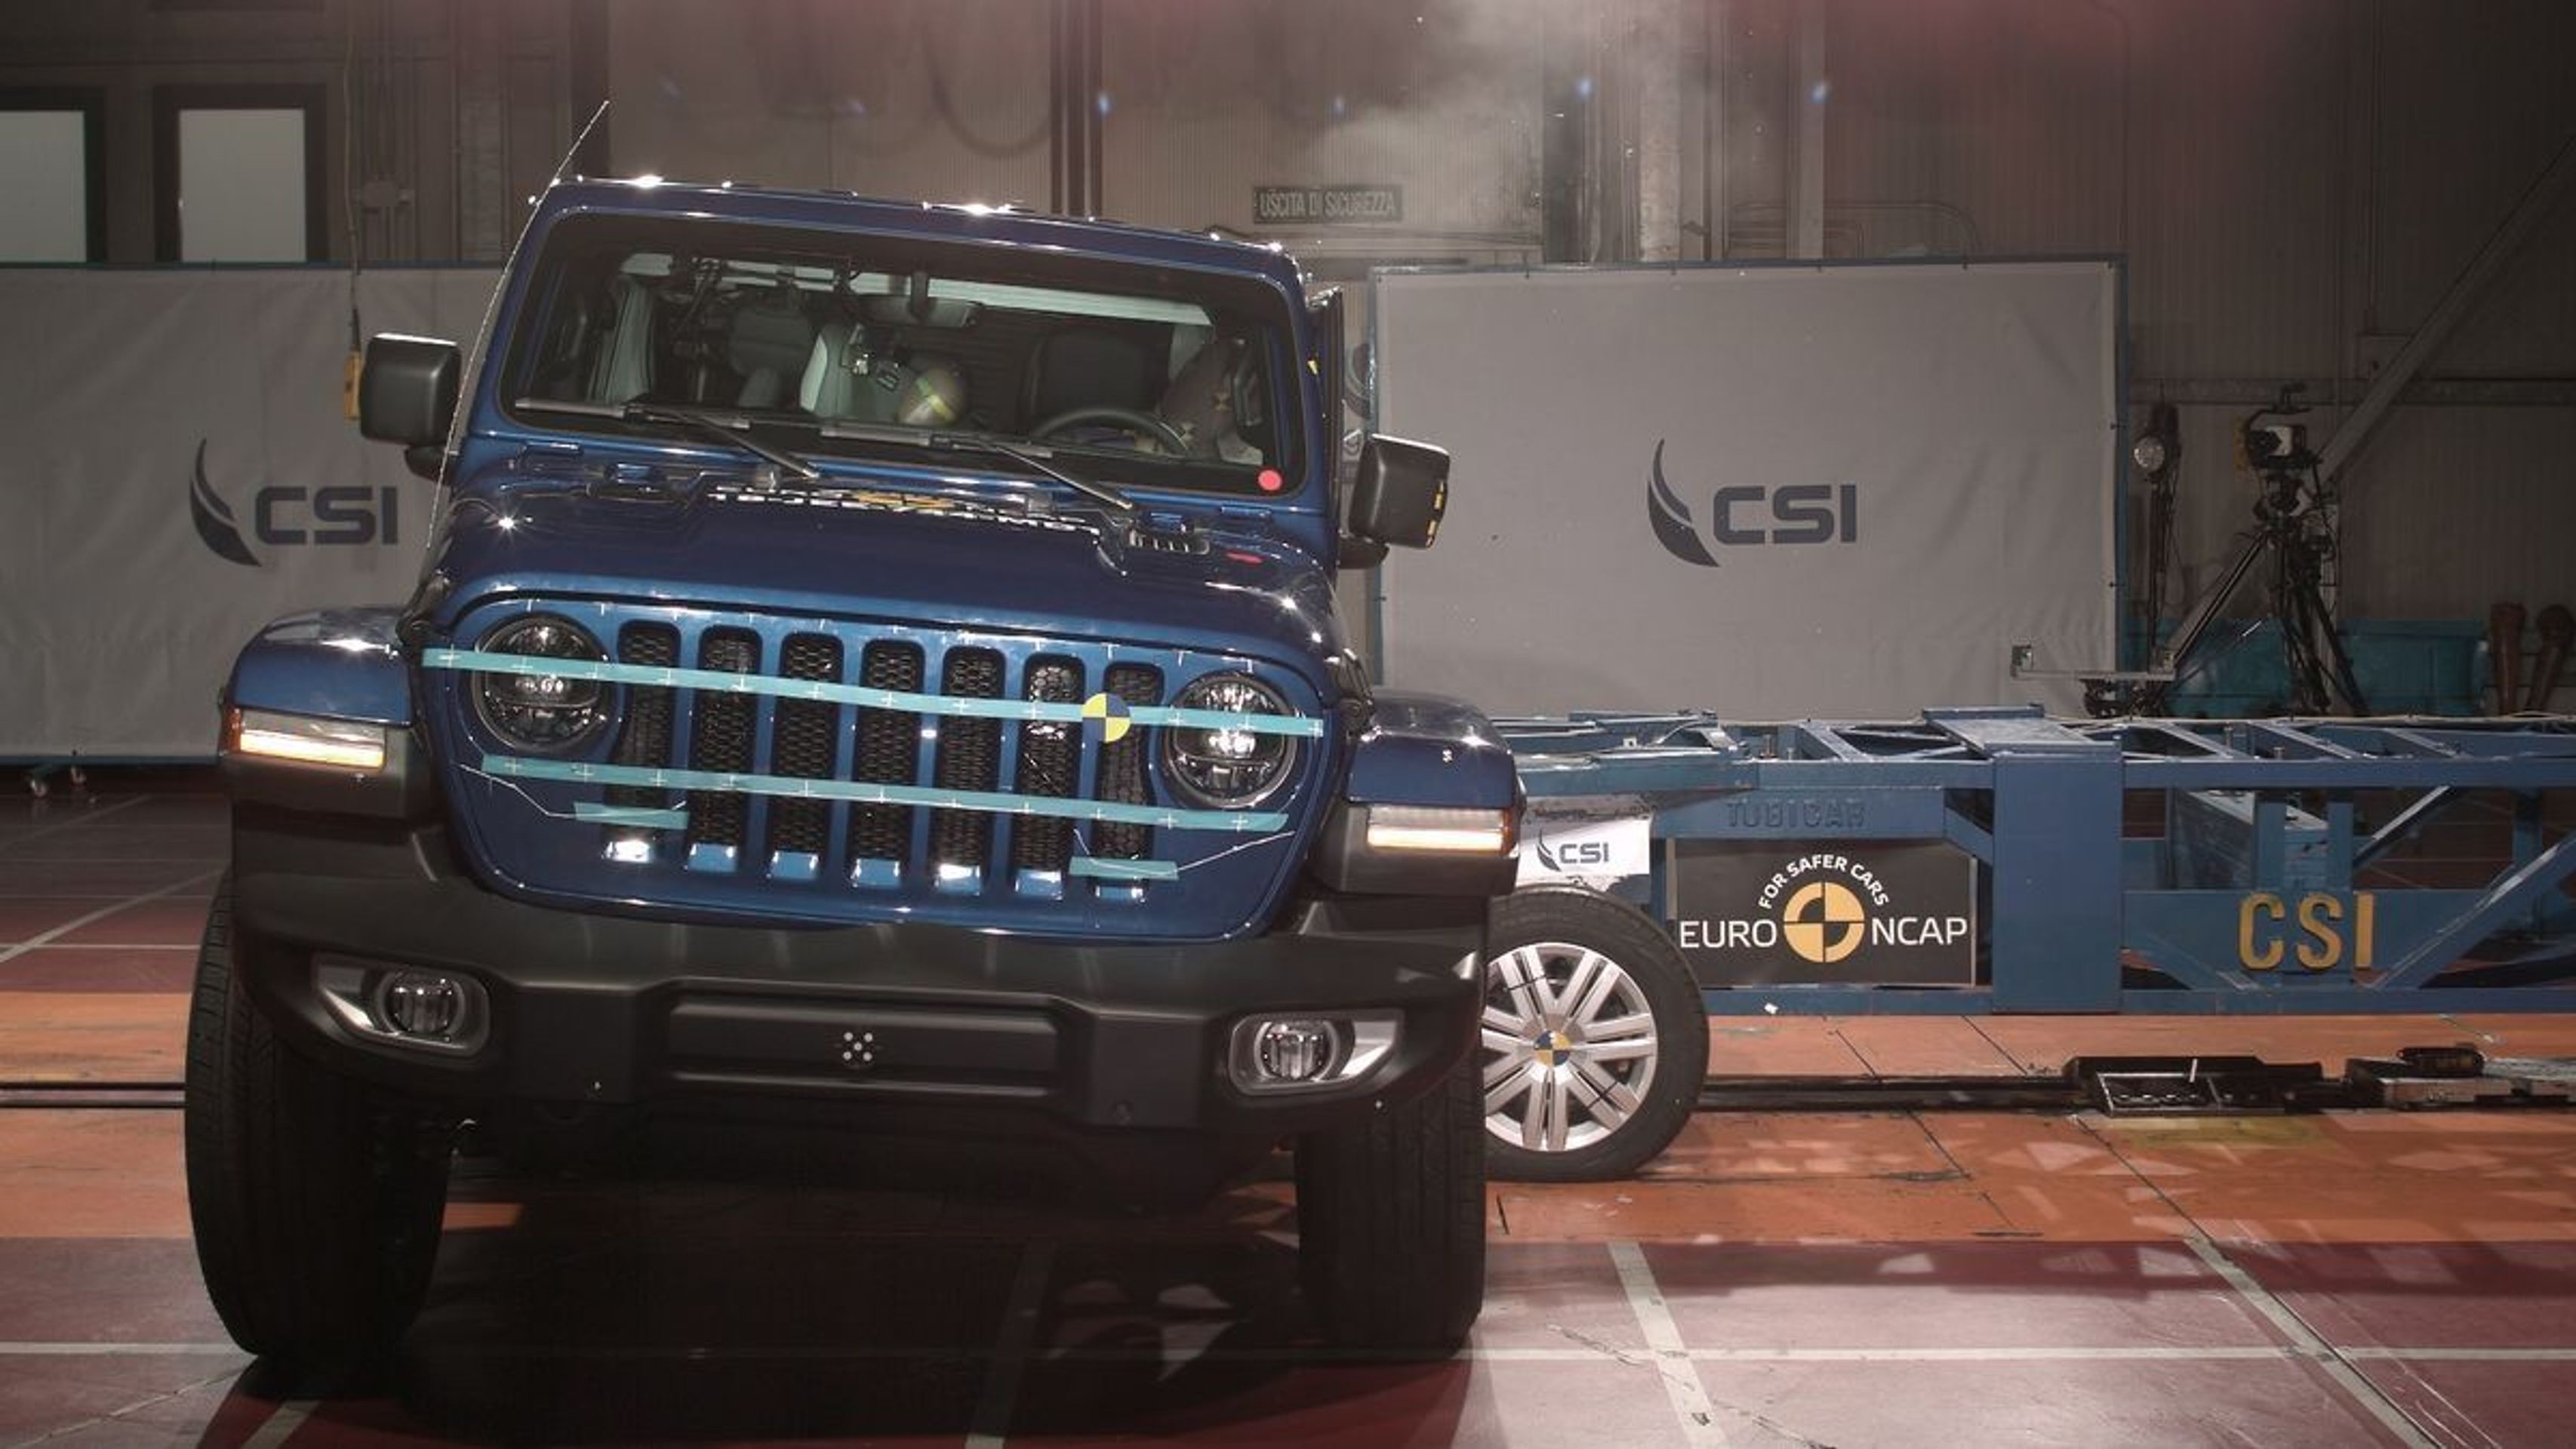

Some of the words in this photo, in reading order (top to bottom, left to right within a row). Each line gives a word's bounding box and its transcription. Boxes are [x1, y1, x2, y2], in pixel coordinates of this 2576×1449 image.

[1260, 192, 1306, 217] USCITA
[1325, 191, 1396, 217] SICUREZZA
[255, 485, 398, 545] CSI
[1713, 485, 1857, 545] CSI
[1559, 842, 1609, 864] CSI
[1758, 872, 1788, 909] FOR
[1786, 854, 1848, 878] SAFER
[1850, 864, 1889, 906] CARS
[1680, 919, 1777, 948] EURO
[1871, 917, 1968, 946] NCAP
[2239, 892, 2374, 970] CSI
